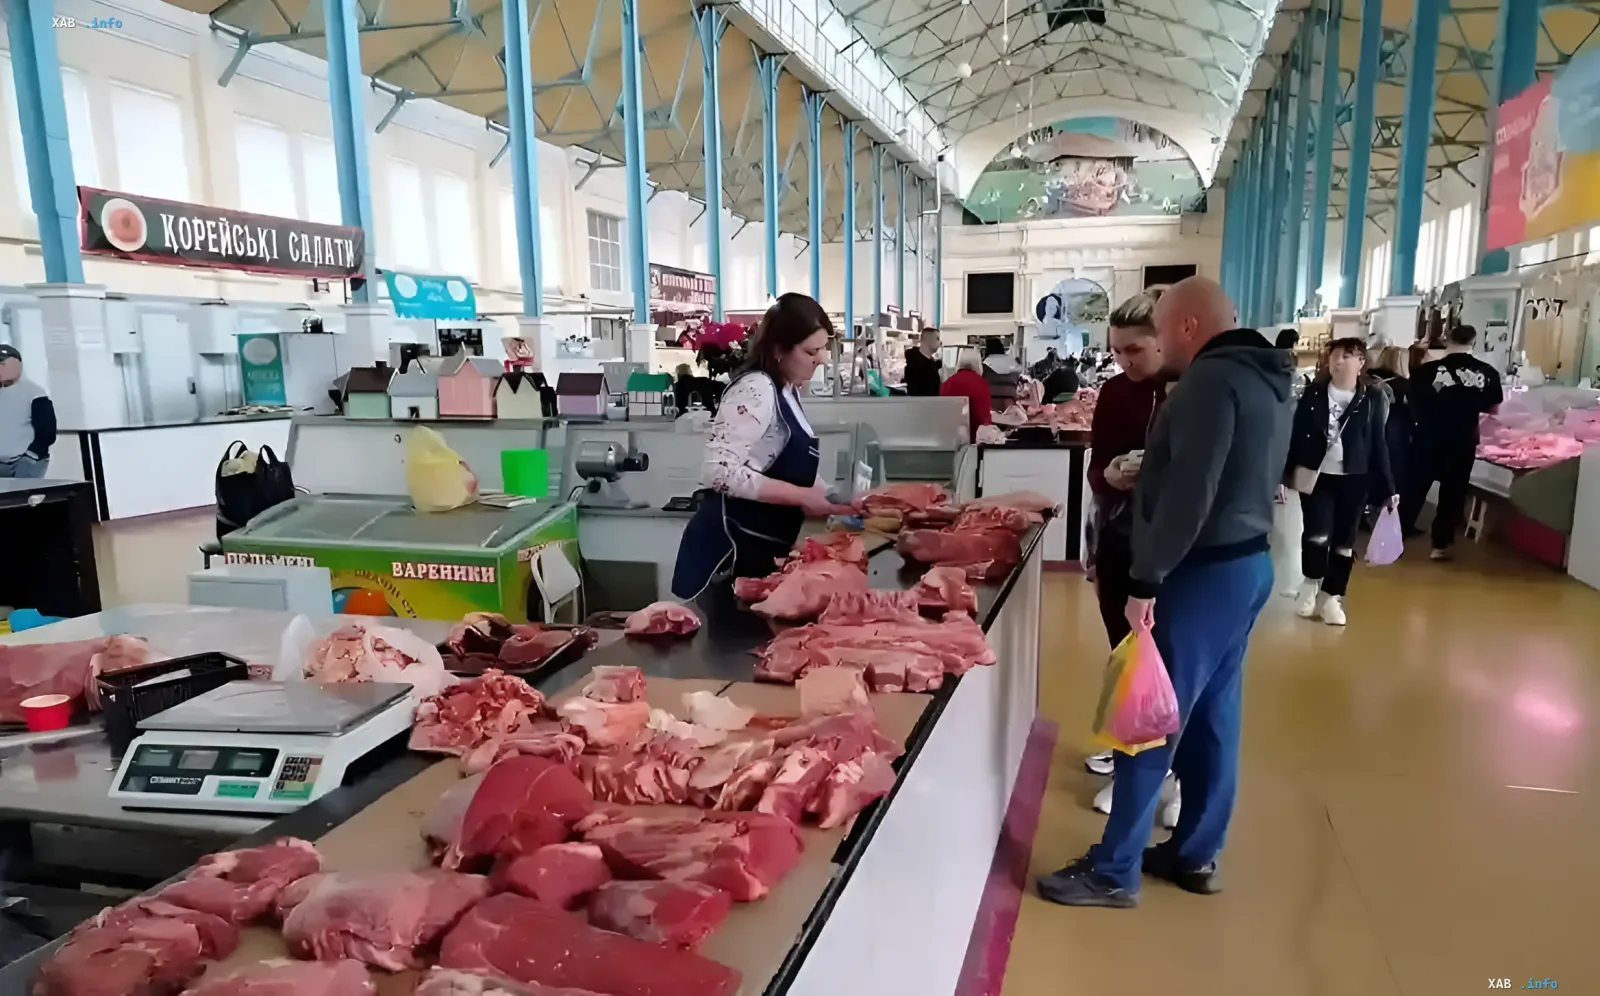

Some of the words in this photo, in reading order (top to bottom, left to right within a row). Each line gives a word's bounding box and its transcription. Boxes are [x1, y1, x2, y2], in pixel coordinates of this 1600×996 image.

[160, 213, 279, 263] КОРЕЙСЬКІ
[288, 231, 355, 268] САЛАТИ
[392, 562, 495, 583] ВАРЕНИКИ
